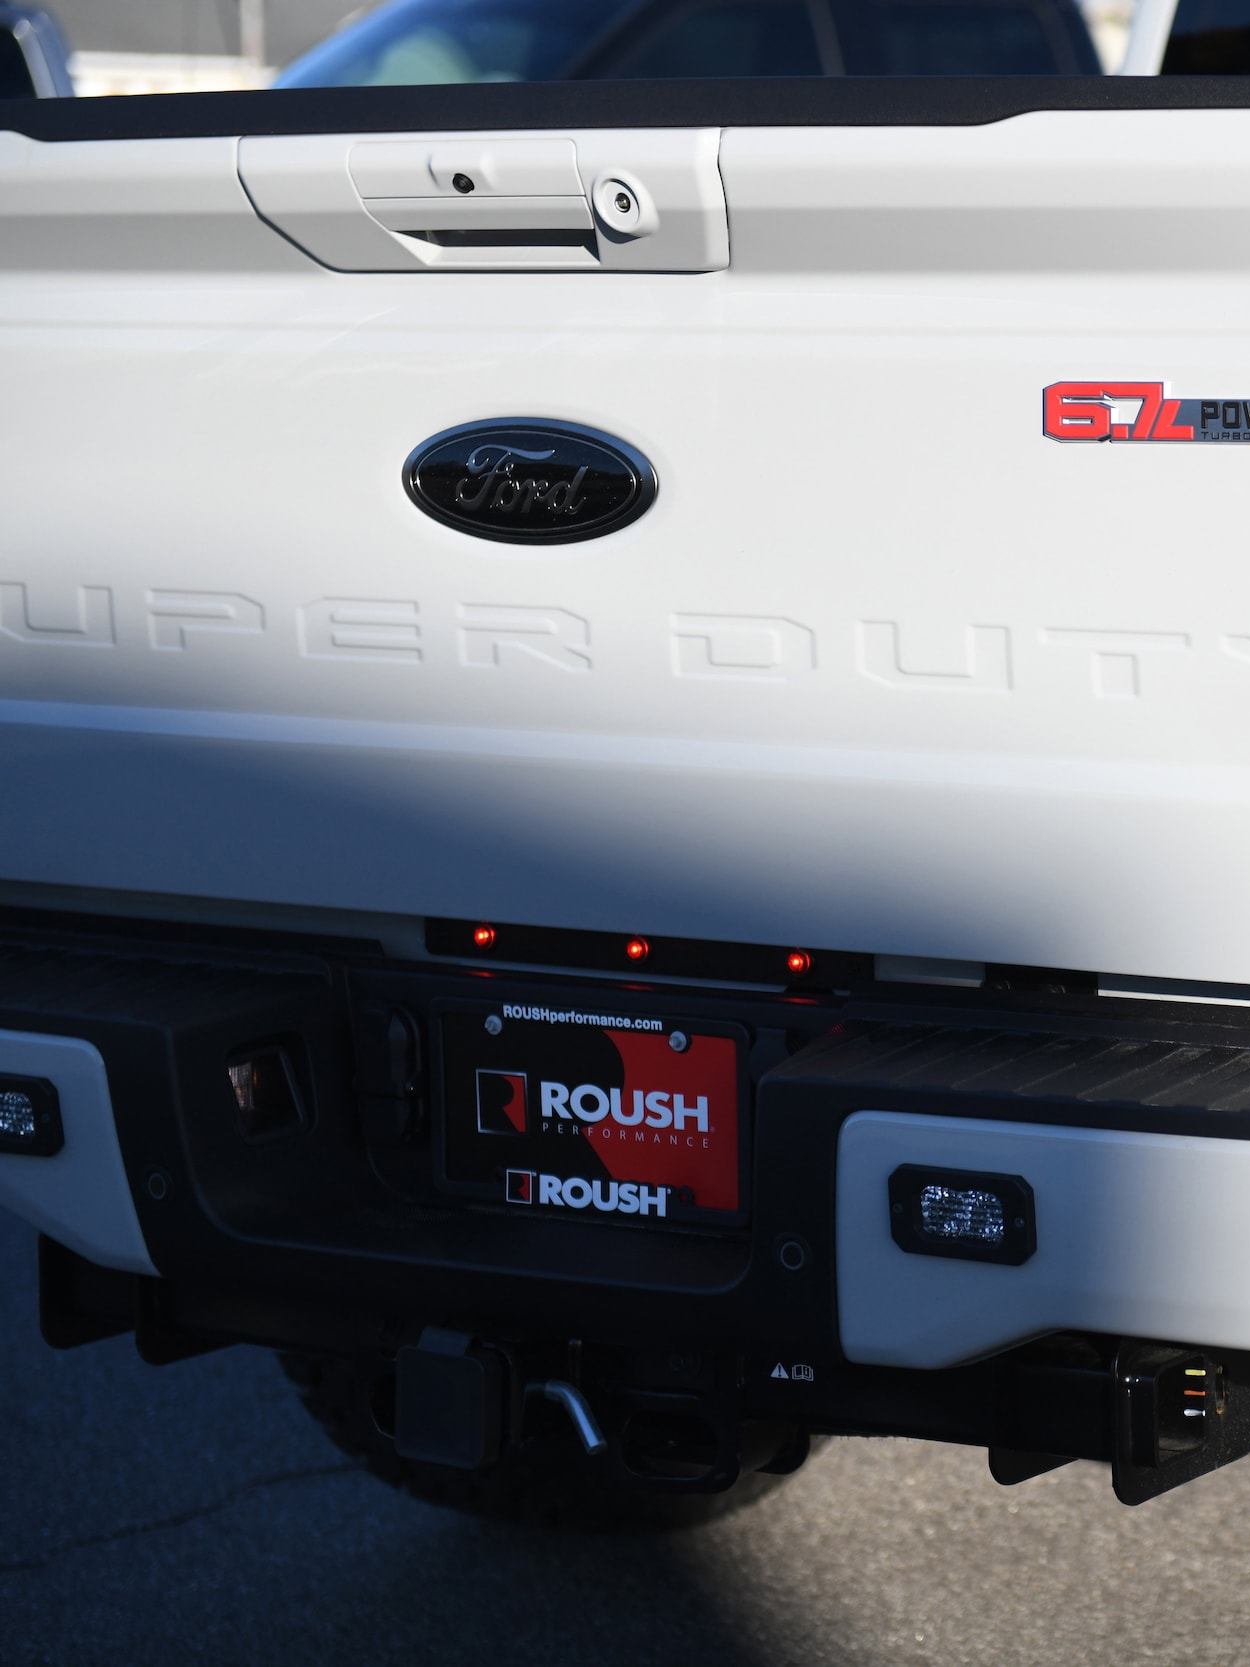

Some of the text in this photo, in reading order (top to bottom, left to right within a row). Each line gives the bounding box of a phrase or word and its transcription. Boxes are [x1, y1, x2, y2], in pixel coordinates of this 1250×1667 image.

[1043, 381, 1195, 441] 6.7L
[454, 444, 589, 516] Ford
[502, 1004, 663, 1031] ROUSHperformance.com
[539, 1080, 710, 1133] ROUSH
[542, 1122, 710, 1149] PERFORMANCE
[538, 1174, 668, 1217] ROUSH
